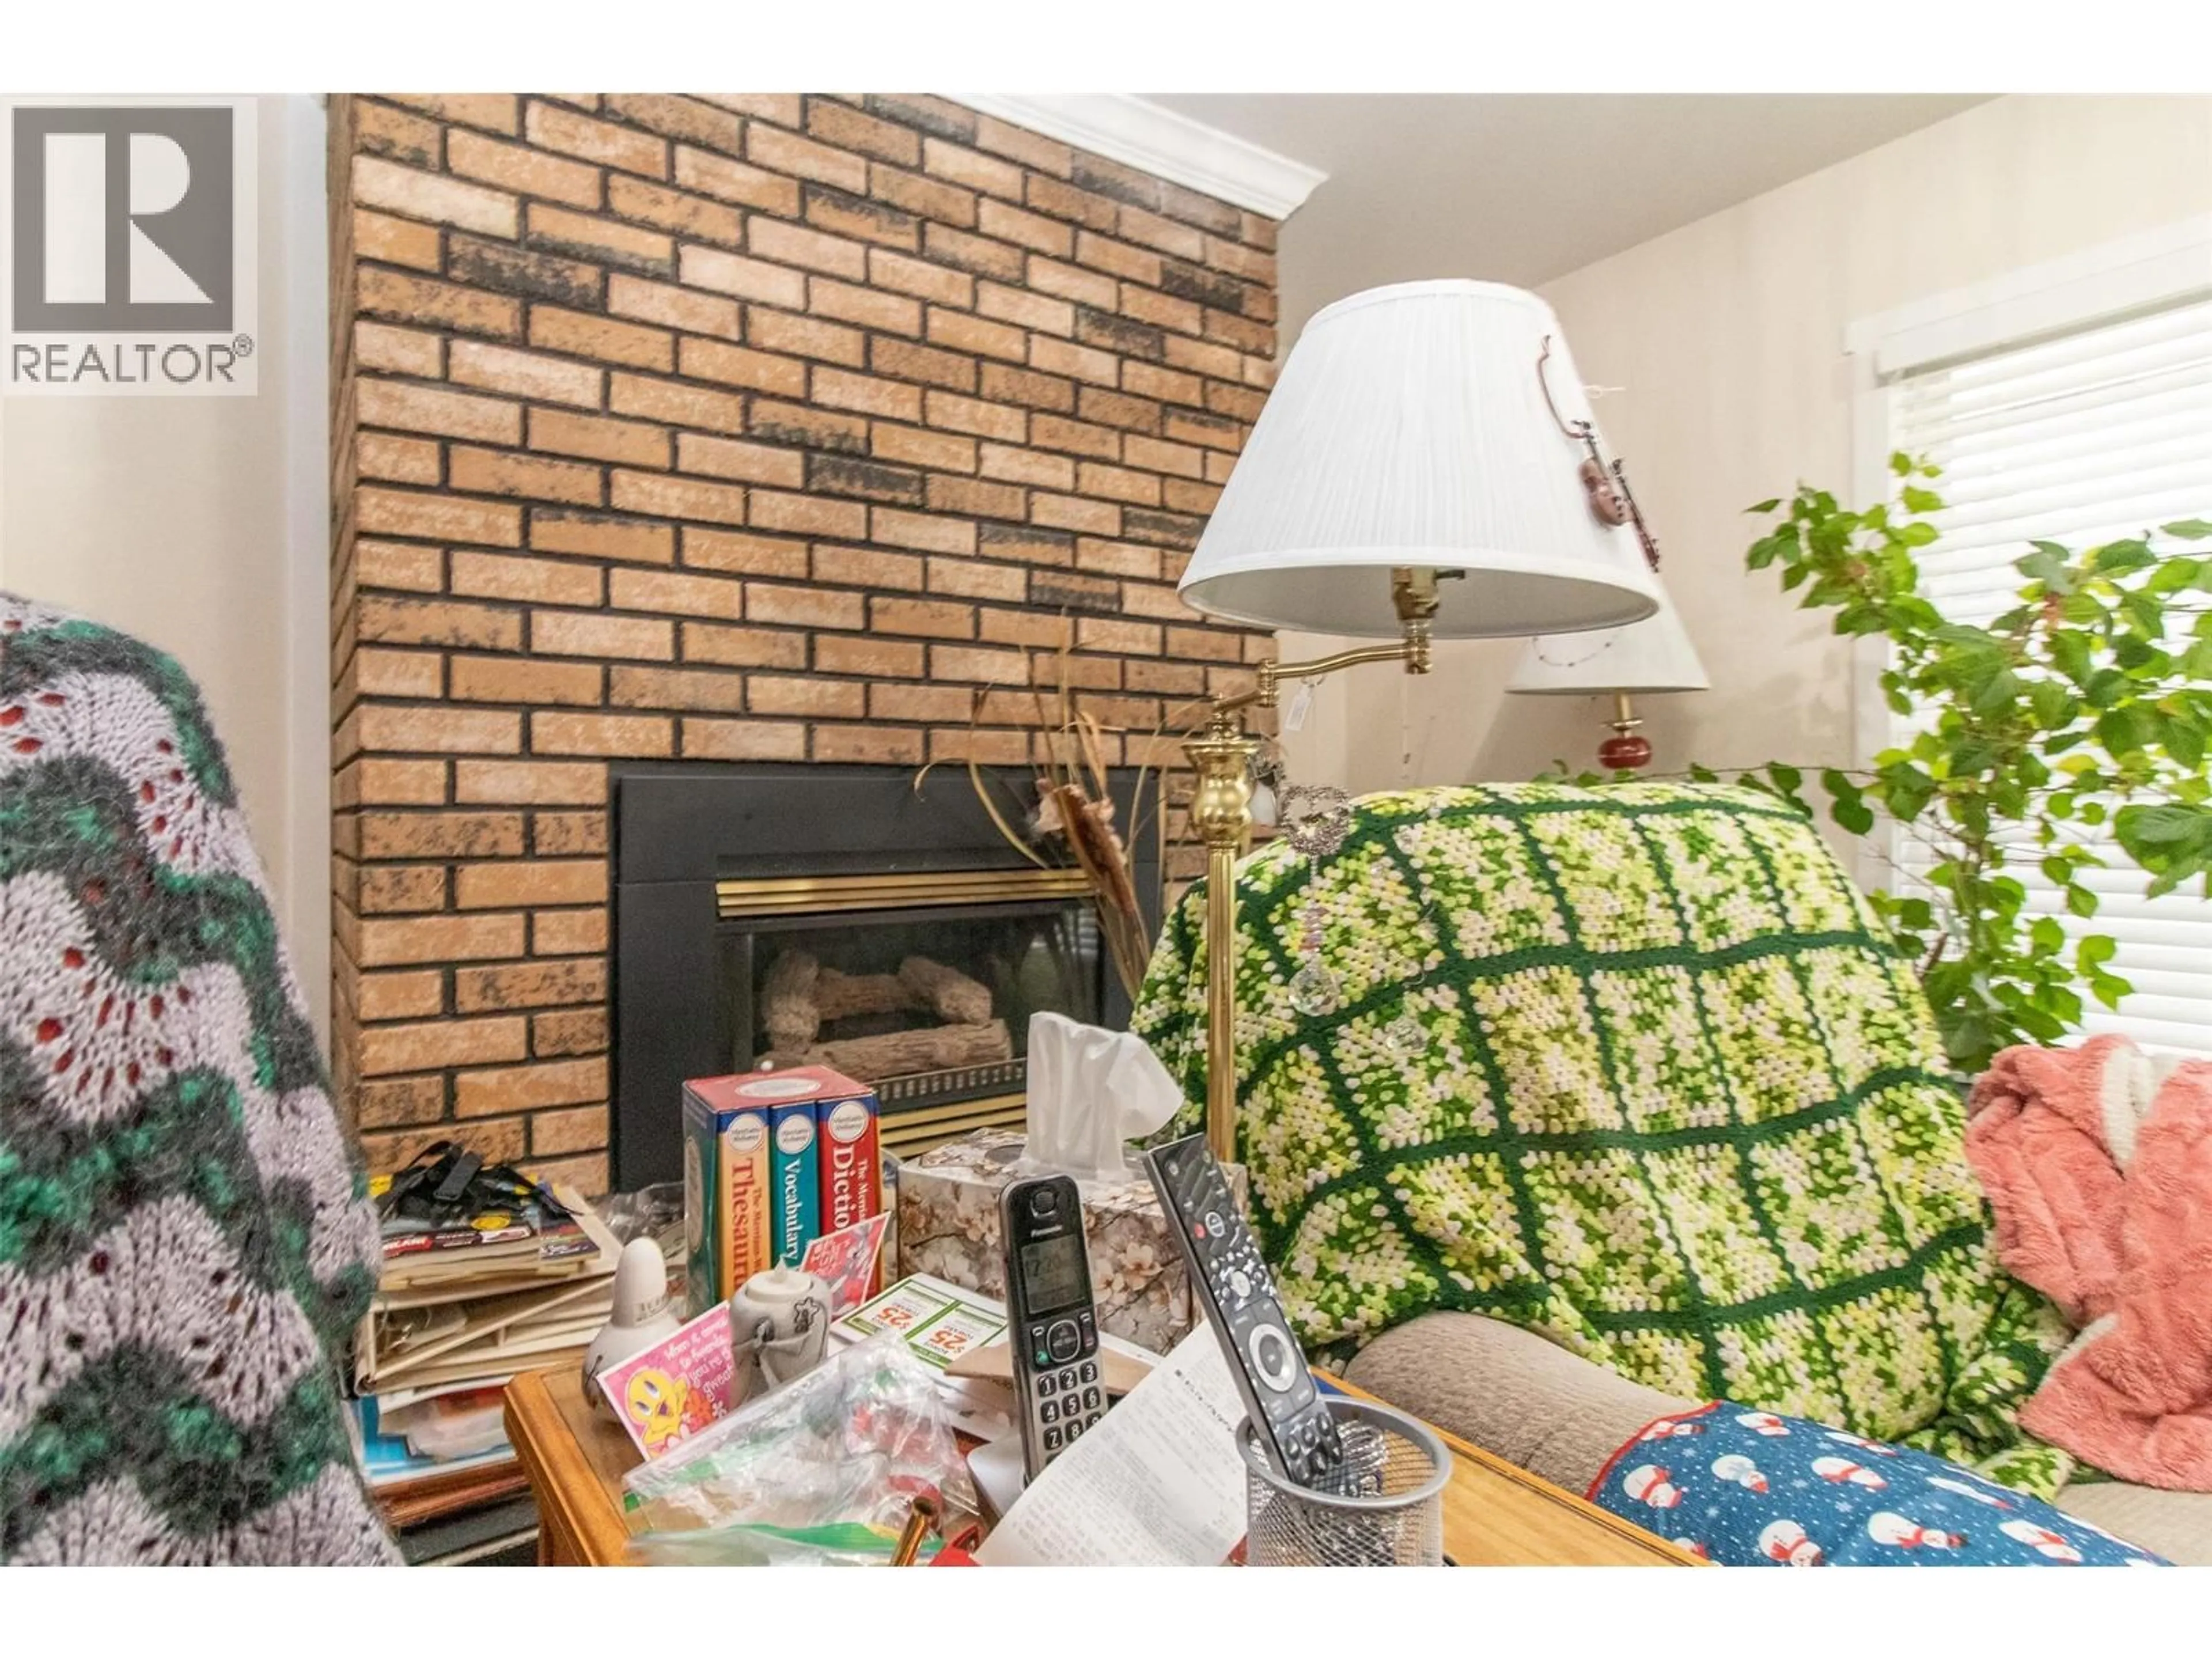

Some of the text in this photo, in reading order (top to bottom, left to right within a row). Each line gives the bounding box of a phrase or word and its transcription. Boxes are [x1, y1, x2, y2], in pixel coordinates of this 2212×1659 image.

[858, 1158, 868, 1180] The
[785, 1158, 803, 1260] Vocabulary
[1086, 1364, 1094, 1376] 3
[1047, 1390, 1097, 1417] 4 5 6
[1071, 1423, 1080, 1435] 8
